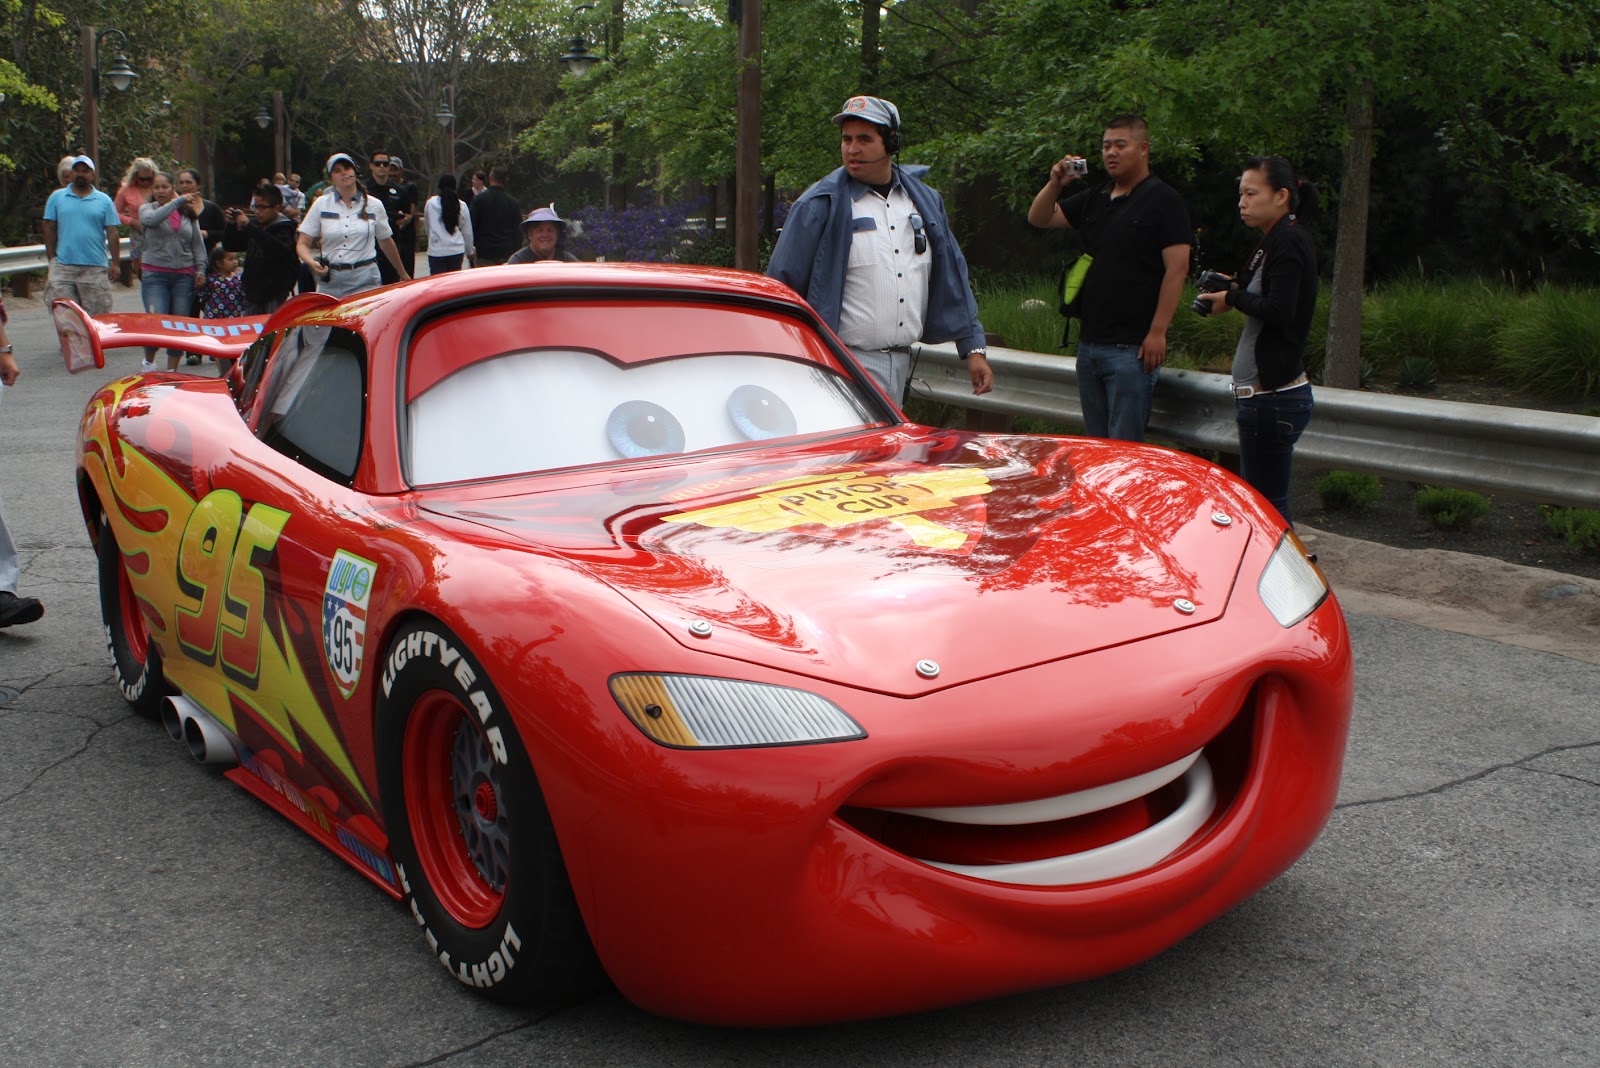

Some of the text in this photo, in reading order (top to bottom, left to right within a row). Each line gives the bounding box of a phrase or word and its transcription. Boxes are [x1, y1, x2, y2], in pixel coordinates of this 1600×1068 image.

[780, 480, 908, 506] PISTON
[836, 494, 910, 513] CUP
[175, 488, 292, 686] 95
[333, 615, 353, 675] 95
[382, 630, 508, 765] LIGHTYEAR
